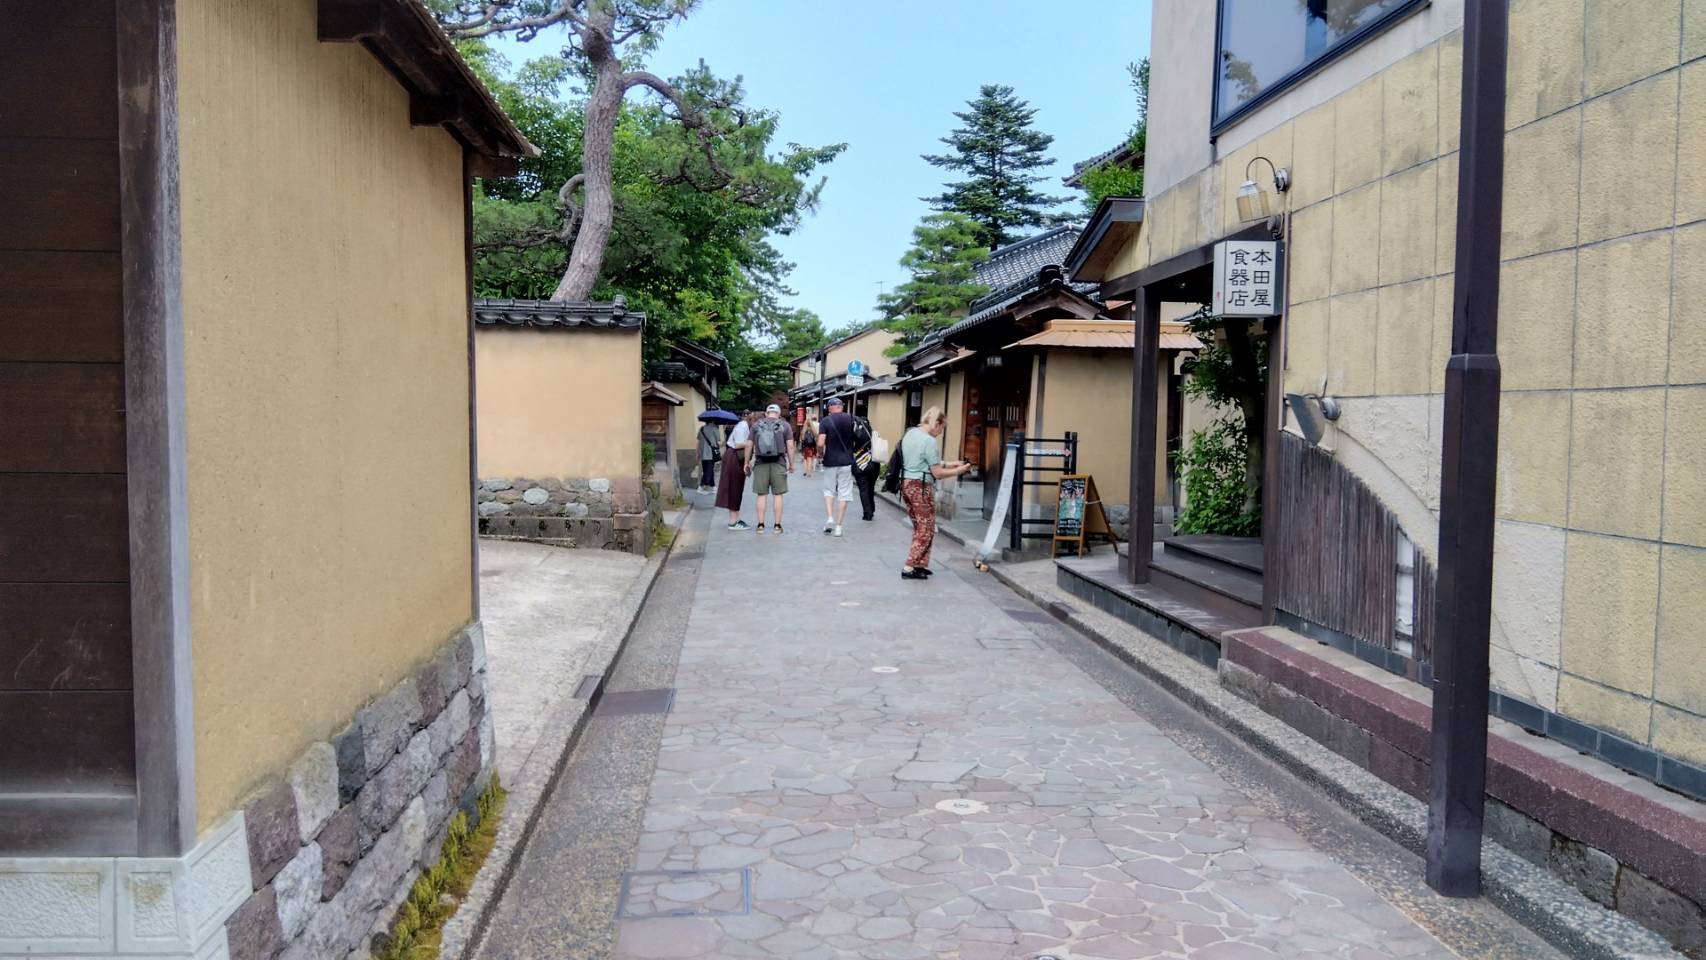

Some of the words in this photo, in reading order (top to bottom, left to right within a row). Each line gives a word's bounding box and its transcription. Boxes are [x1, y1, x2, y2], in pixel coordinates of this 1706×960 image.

[1227, 248, 1250, 307] 食器店
[1250, 248, 1273, 307] 本田屋
